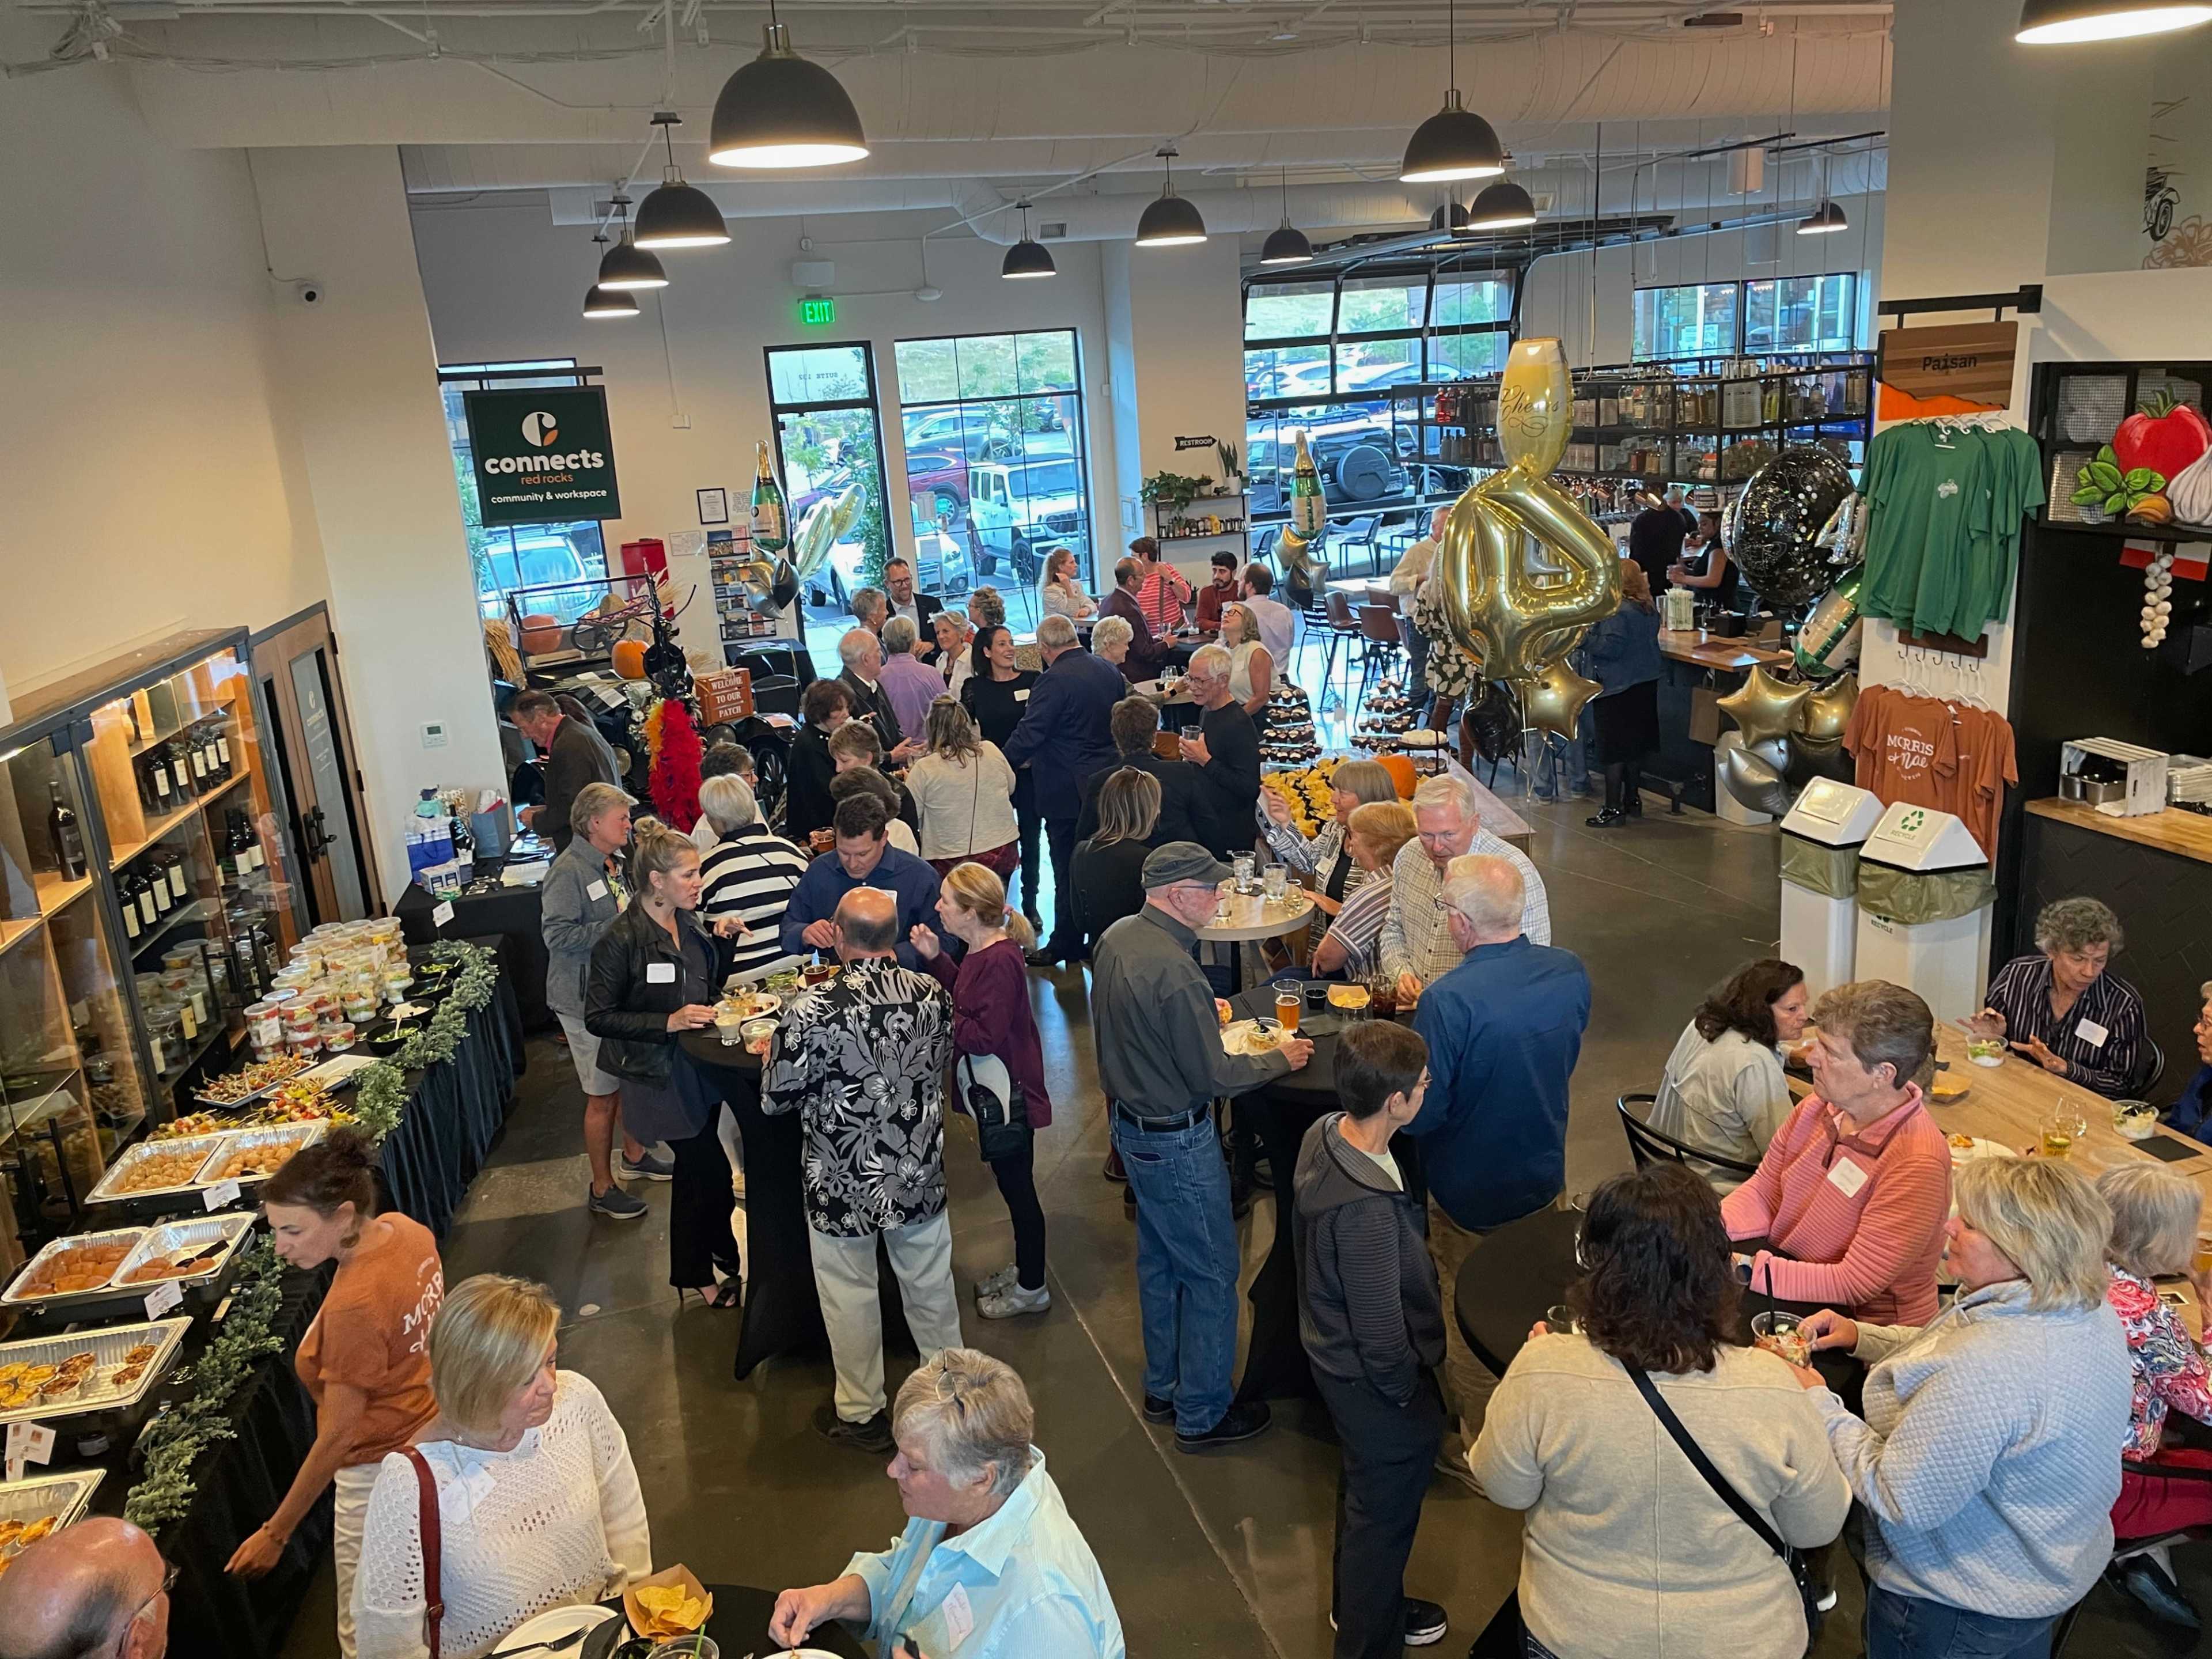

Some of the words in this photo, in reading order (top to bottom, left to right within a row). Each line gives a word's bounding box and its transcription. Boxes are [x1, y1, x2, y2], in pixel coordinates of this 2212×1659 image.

[805, 302, 830, 323] EXIT
[1922, 354, 1977, 371] Paisan
[1500, 385, 1559, 422] Ches
[1180, 438, 1213, 446] RESTROOM
[484, 449, 604, 475] connects
[521, 473, 541, 485] red
[543, 472, 574, 483] rocks
[491, 492, 544, 504] community
[546, 491, 553, 500] &
[555, 488, 607, 499] workspace
[711, 676, 743, 690] WELCOME
[716, 695, 726, 704] TO
[728, 692, 741, 702] OUR
[718, 706, 741, 718] PATCH
[1887, 734, 1934, 756] MORRIS
[1890, 830, 1916, 840] RECYCLE
[1871, 919, 1893, 934] RECYCLE
